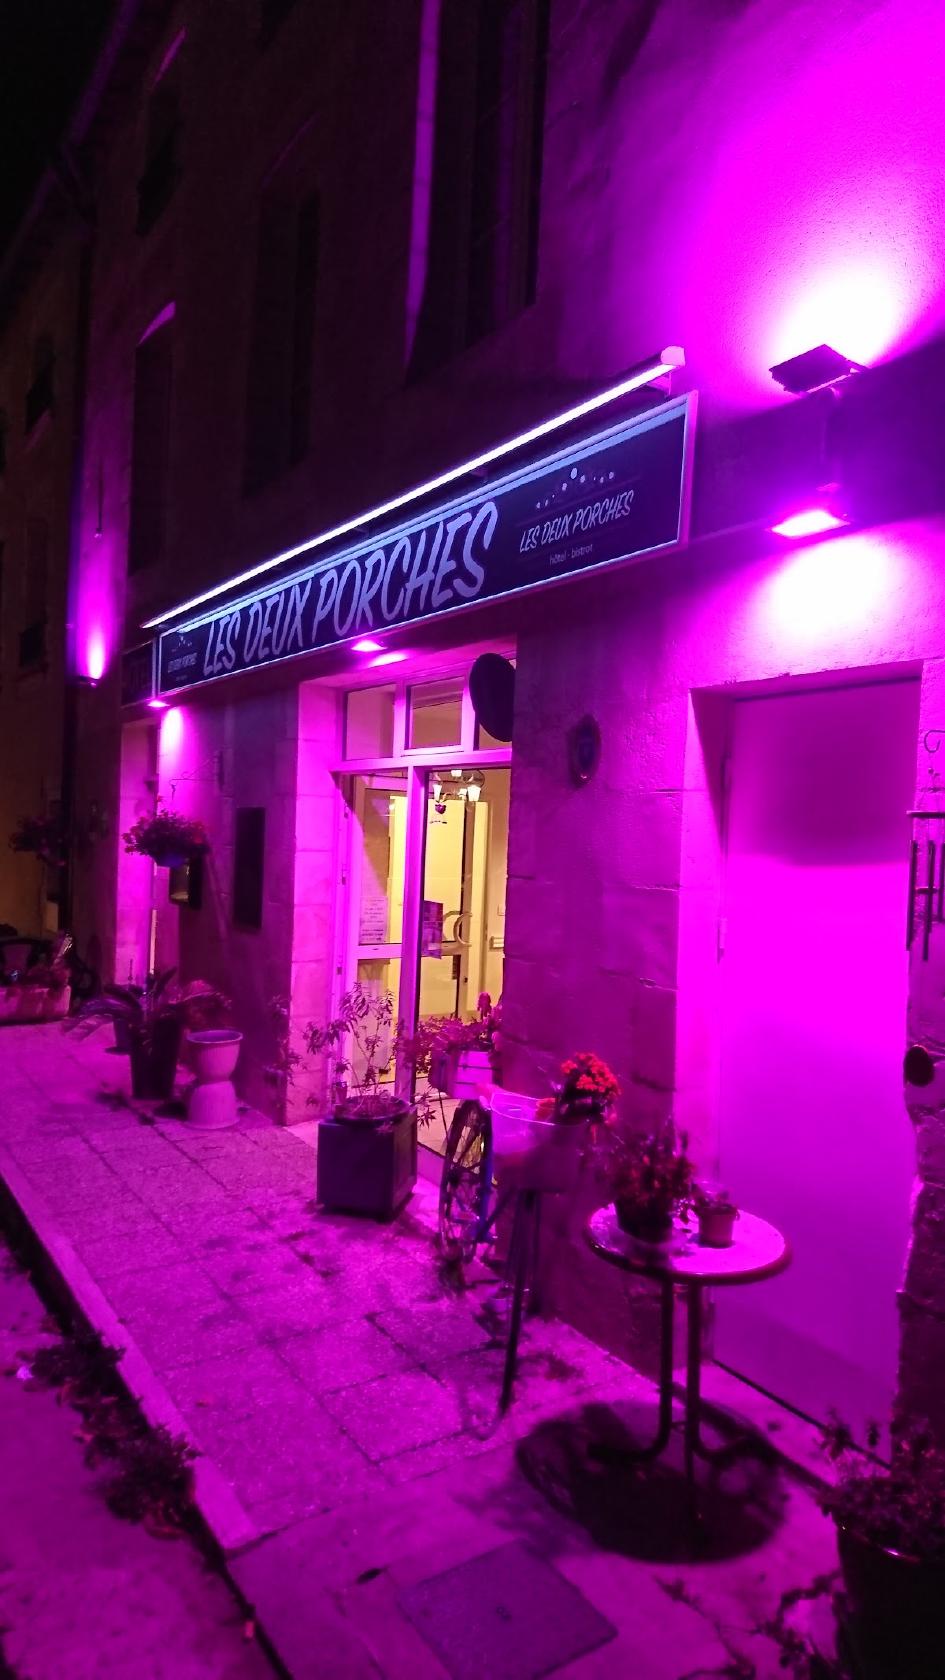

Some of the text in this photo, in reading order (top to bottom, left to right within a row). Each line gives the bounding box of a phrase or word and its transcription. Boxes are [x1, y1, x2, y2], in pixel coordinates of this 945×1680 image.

[519, 489, 634, 553] LES DEUX PORCHES
[571, 544, 593, 559] bistrot
[203, 610, 241, 677] LES
[243, 577, 313, 663] DEUX
[311, 501, 499, 643] PORCHES
